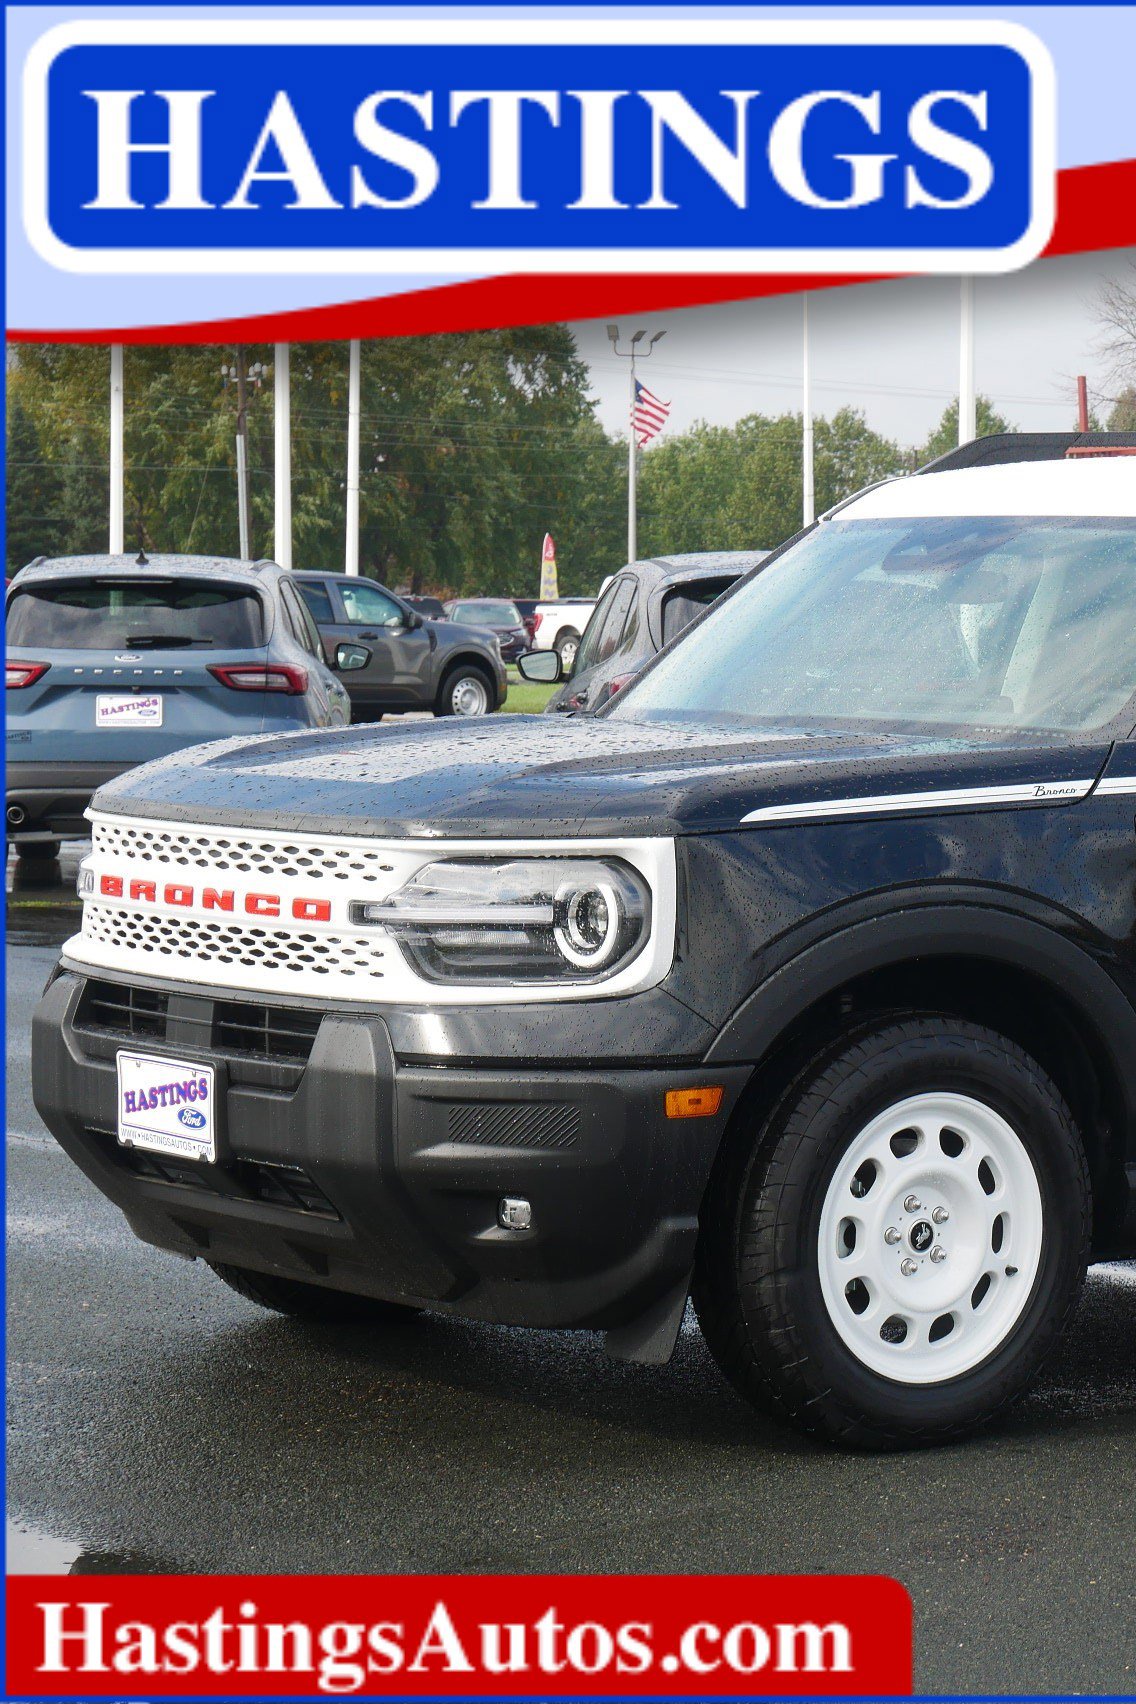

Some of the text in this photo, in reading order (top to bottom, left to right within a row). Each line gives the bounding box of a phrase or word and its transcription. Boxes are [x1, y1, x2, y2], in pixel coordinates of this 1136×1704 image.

[1032, 785, 1078, 797] Bronco
[100, 874, 331, 922] BRONCO
[124, 1078, 208, 1114] HASTINGS
[182, 1108, 202, 1126] Ford
